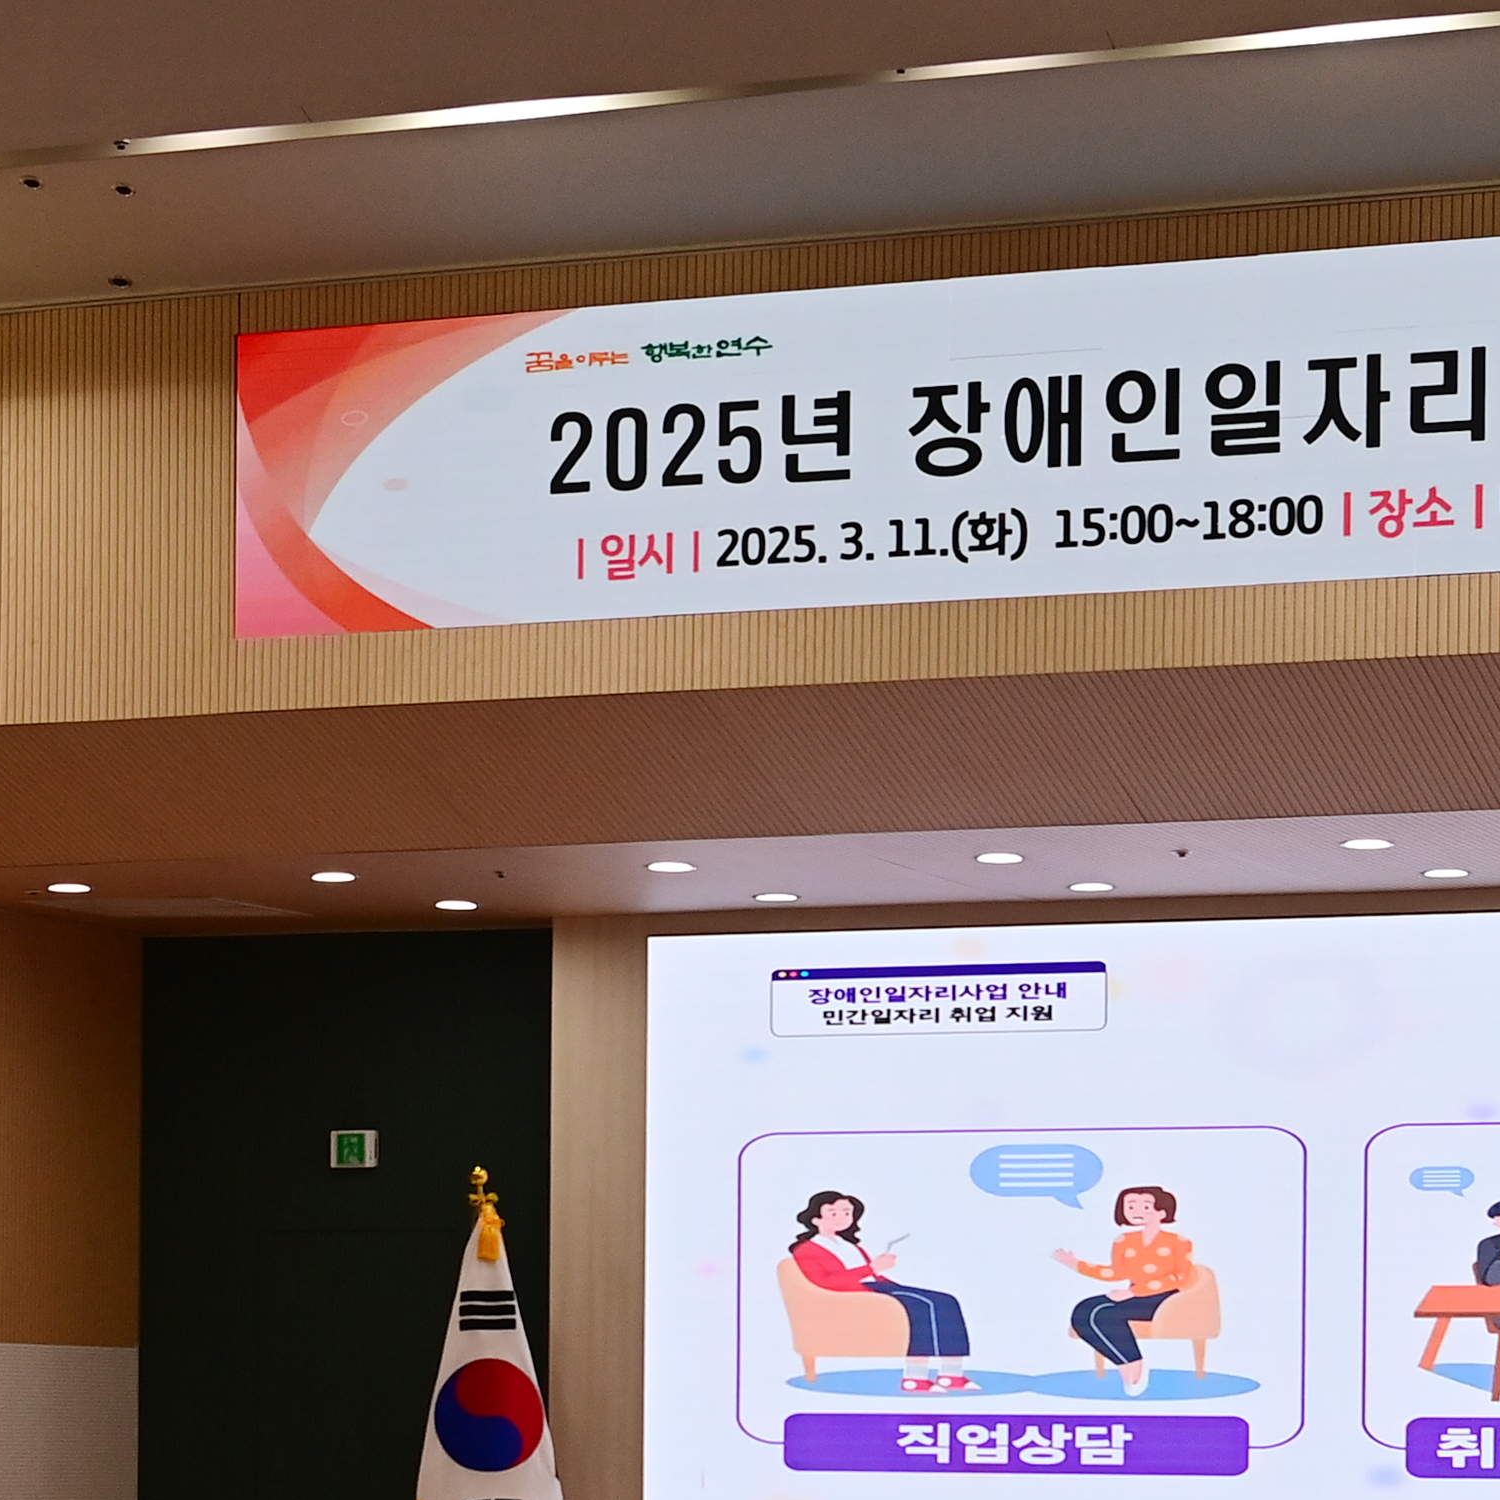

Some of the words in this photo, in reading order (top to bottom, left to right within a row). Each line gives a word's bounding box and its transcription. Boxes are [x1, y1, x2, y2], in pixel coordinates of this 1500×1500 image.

[549, 390, 851, 495] 2025년
[908, 345, 1487, 478] 장애인일자리
[716, 524, 827, 568] 2025.
[839, 521, 875, 561] 3.
[888, 507, 1028, 564] 11.(화)
[1055, 494, 1324, 549] 15:00~18:00
[808, 982, 1008, 1005] 장애인일자리사업
[1018, 981, 1067, 1000] 안내
[822, 1007, 940, 1026] 민간일자리
[949, 1005, 996, 1023] 취업
[1005, 1004, 1053, 1022] 지원
[896, 1422, 1133, 1466] 직업상담
